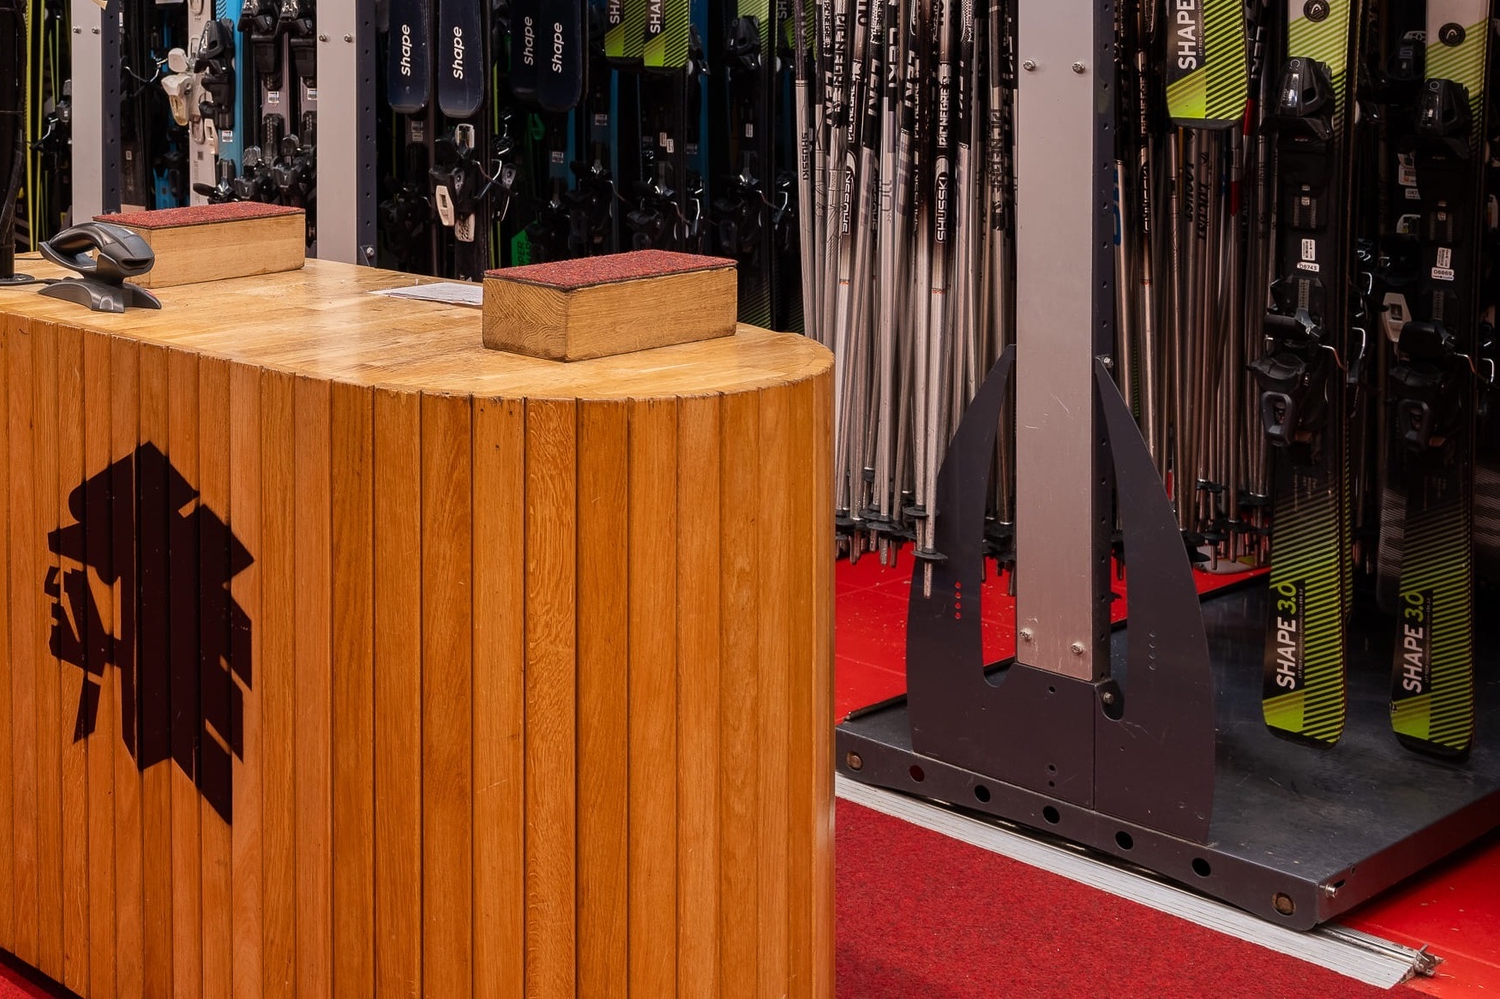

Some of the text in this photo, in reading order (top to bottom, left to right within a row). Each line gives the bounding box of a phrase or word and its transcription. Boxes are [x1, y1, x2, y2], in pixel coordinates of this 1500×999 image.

[401, 24, 411, 76] shape
[453, 26, 463, 79] shape
[525, 16, 533, 65] shape
[552, 22, 563, 73] shape
[888, 27, 898, 88] LEKI
[937, 176, 949, 241] SHUSSKI
[1276, 581, 1297, 690] SHAPE 3.0
[1402, 590, 1423, 694] SHAPE 3.0
